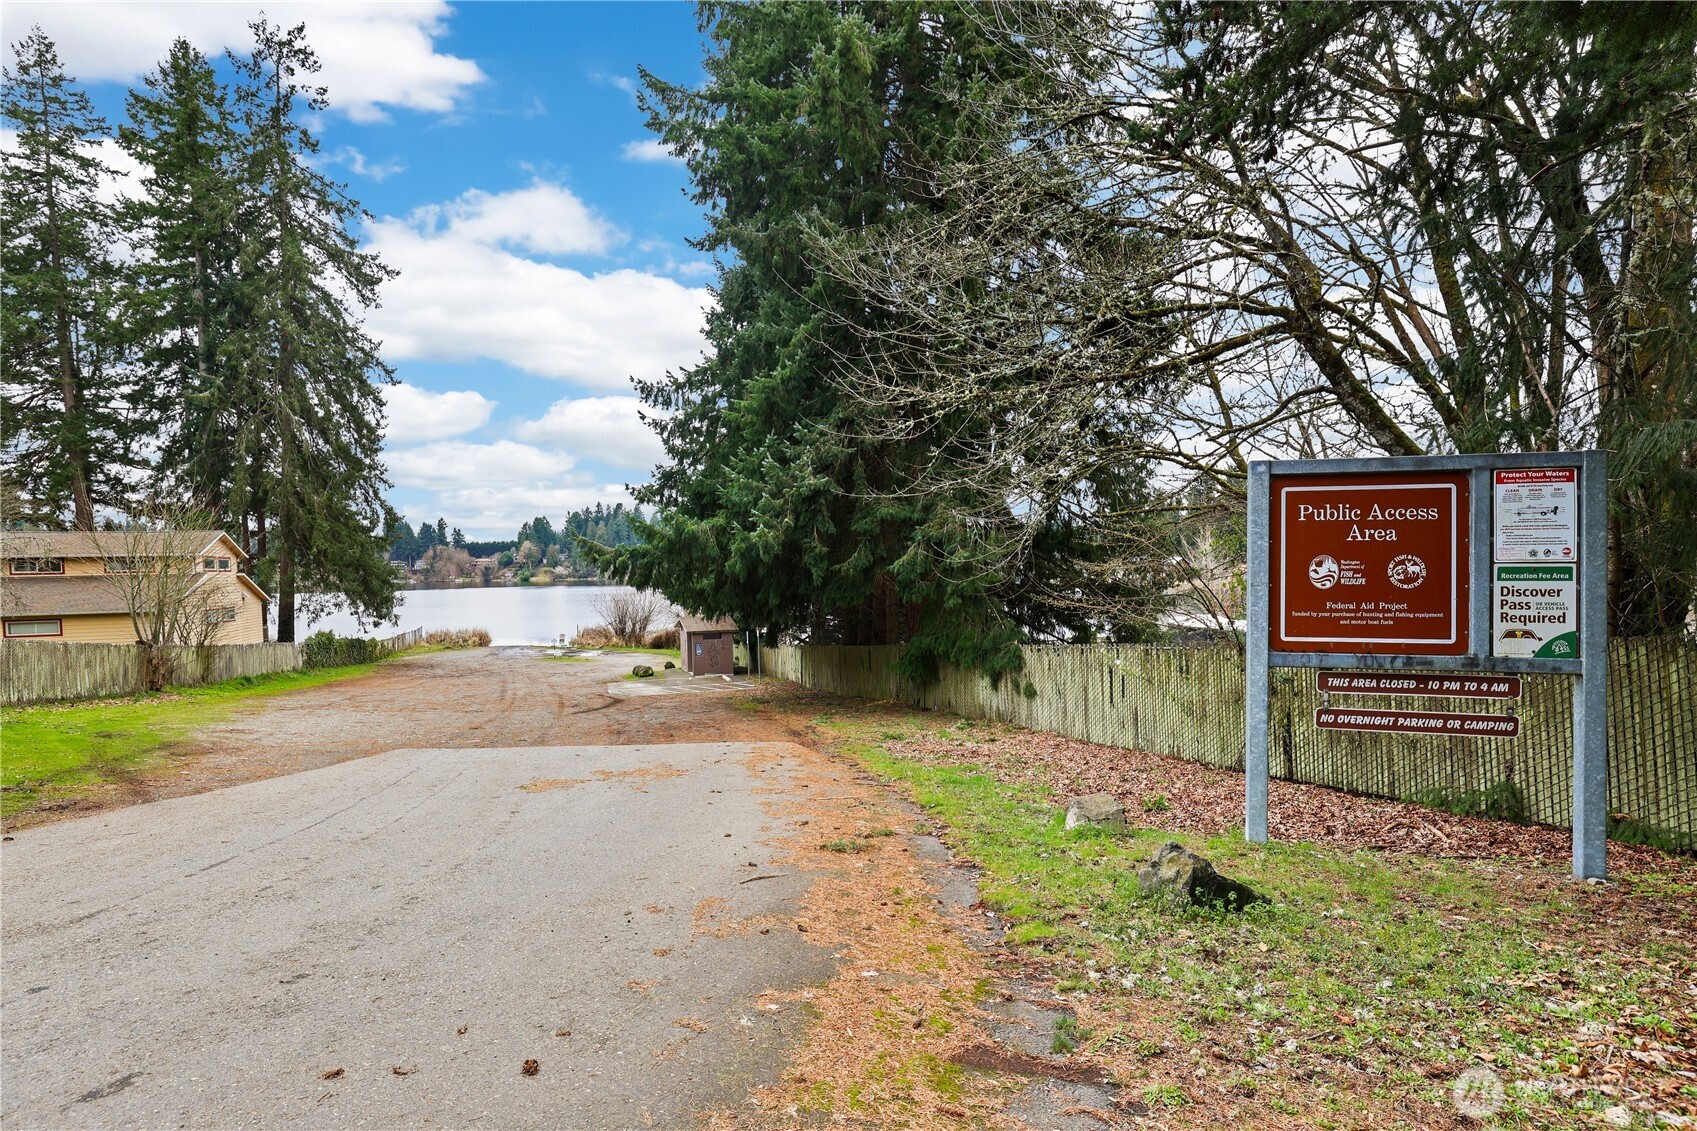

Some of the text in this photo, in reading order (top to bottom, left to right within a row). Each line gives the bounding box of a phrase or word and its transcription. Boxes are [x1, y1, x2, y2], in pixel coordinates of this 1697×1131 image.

[1298, 504, 1438, 520] Public Access
[1346, 524, 1397, 541] Area
[1500, 586, 1563, 597] Discover
[1379, 602, 1408, 611] Project
[1500, 599, 1531, 610] Pass
[1500, 612, 1566, 626] Required
[1328, 678, 1349, 687] THIS
[1352, 678, 1377, 688] AREA
[1380, 679, 1416, 689] CLOSED
[1428, 681, 1439, 690] 10
[1443, 681, 1460, 690] PM
[1464, 682, 1477, 691] TO
[1480, 682, 1488, 691] 4
[1491, 683, 1509, 692] AM
[1320, 714, 1514, 731] NO OVERNIGHT PARKING OR CAMPING
